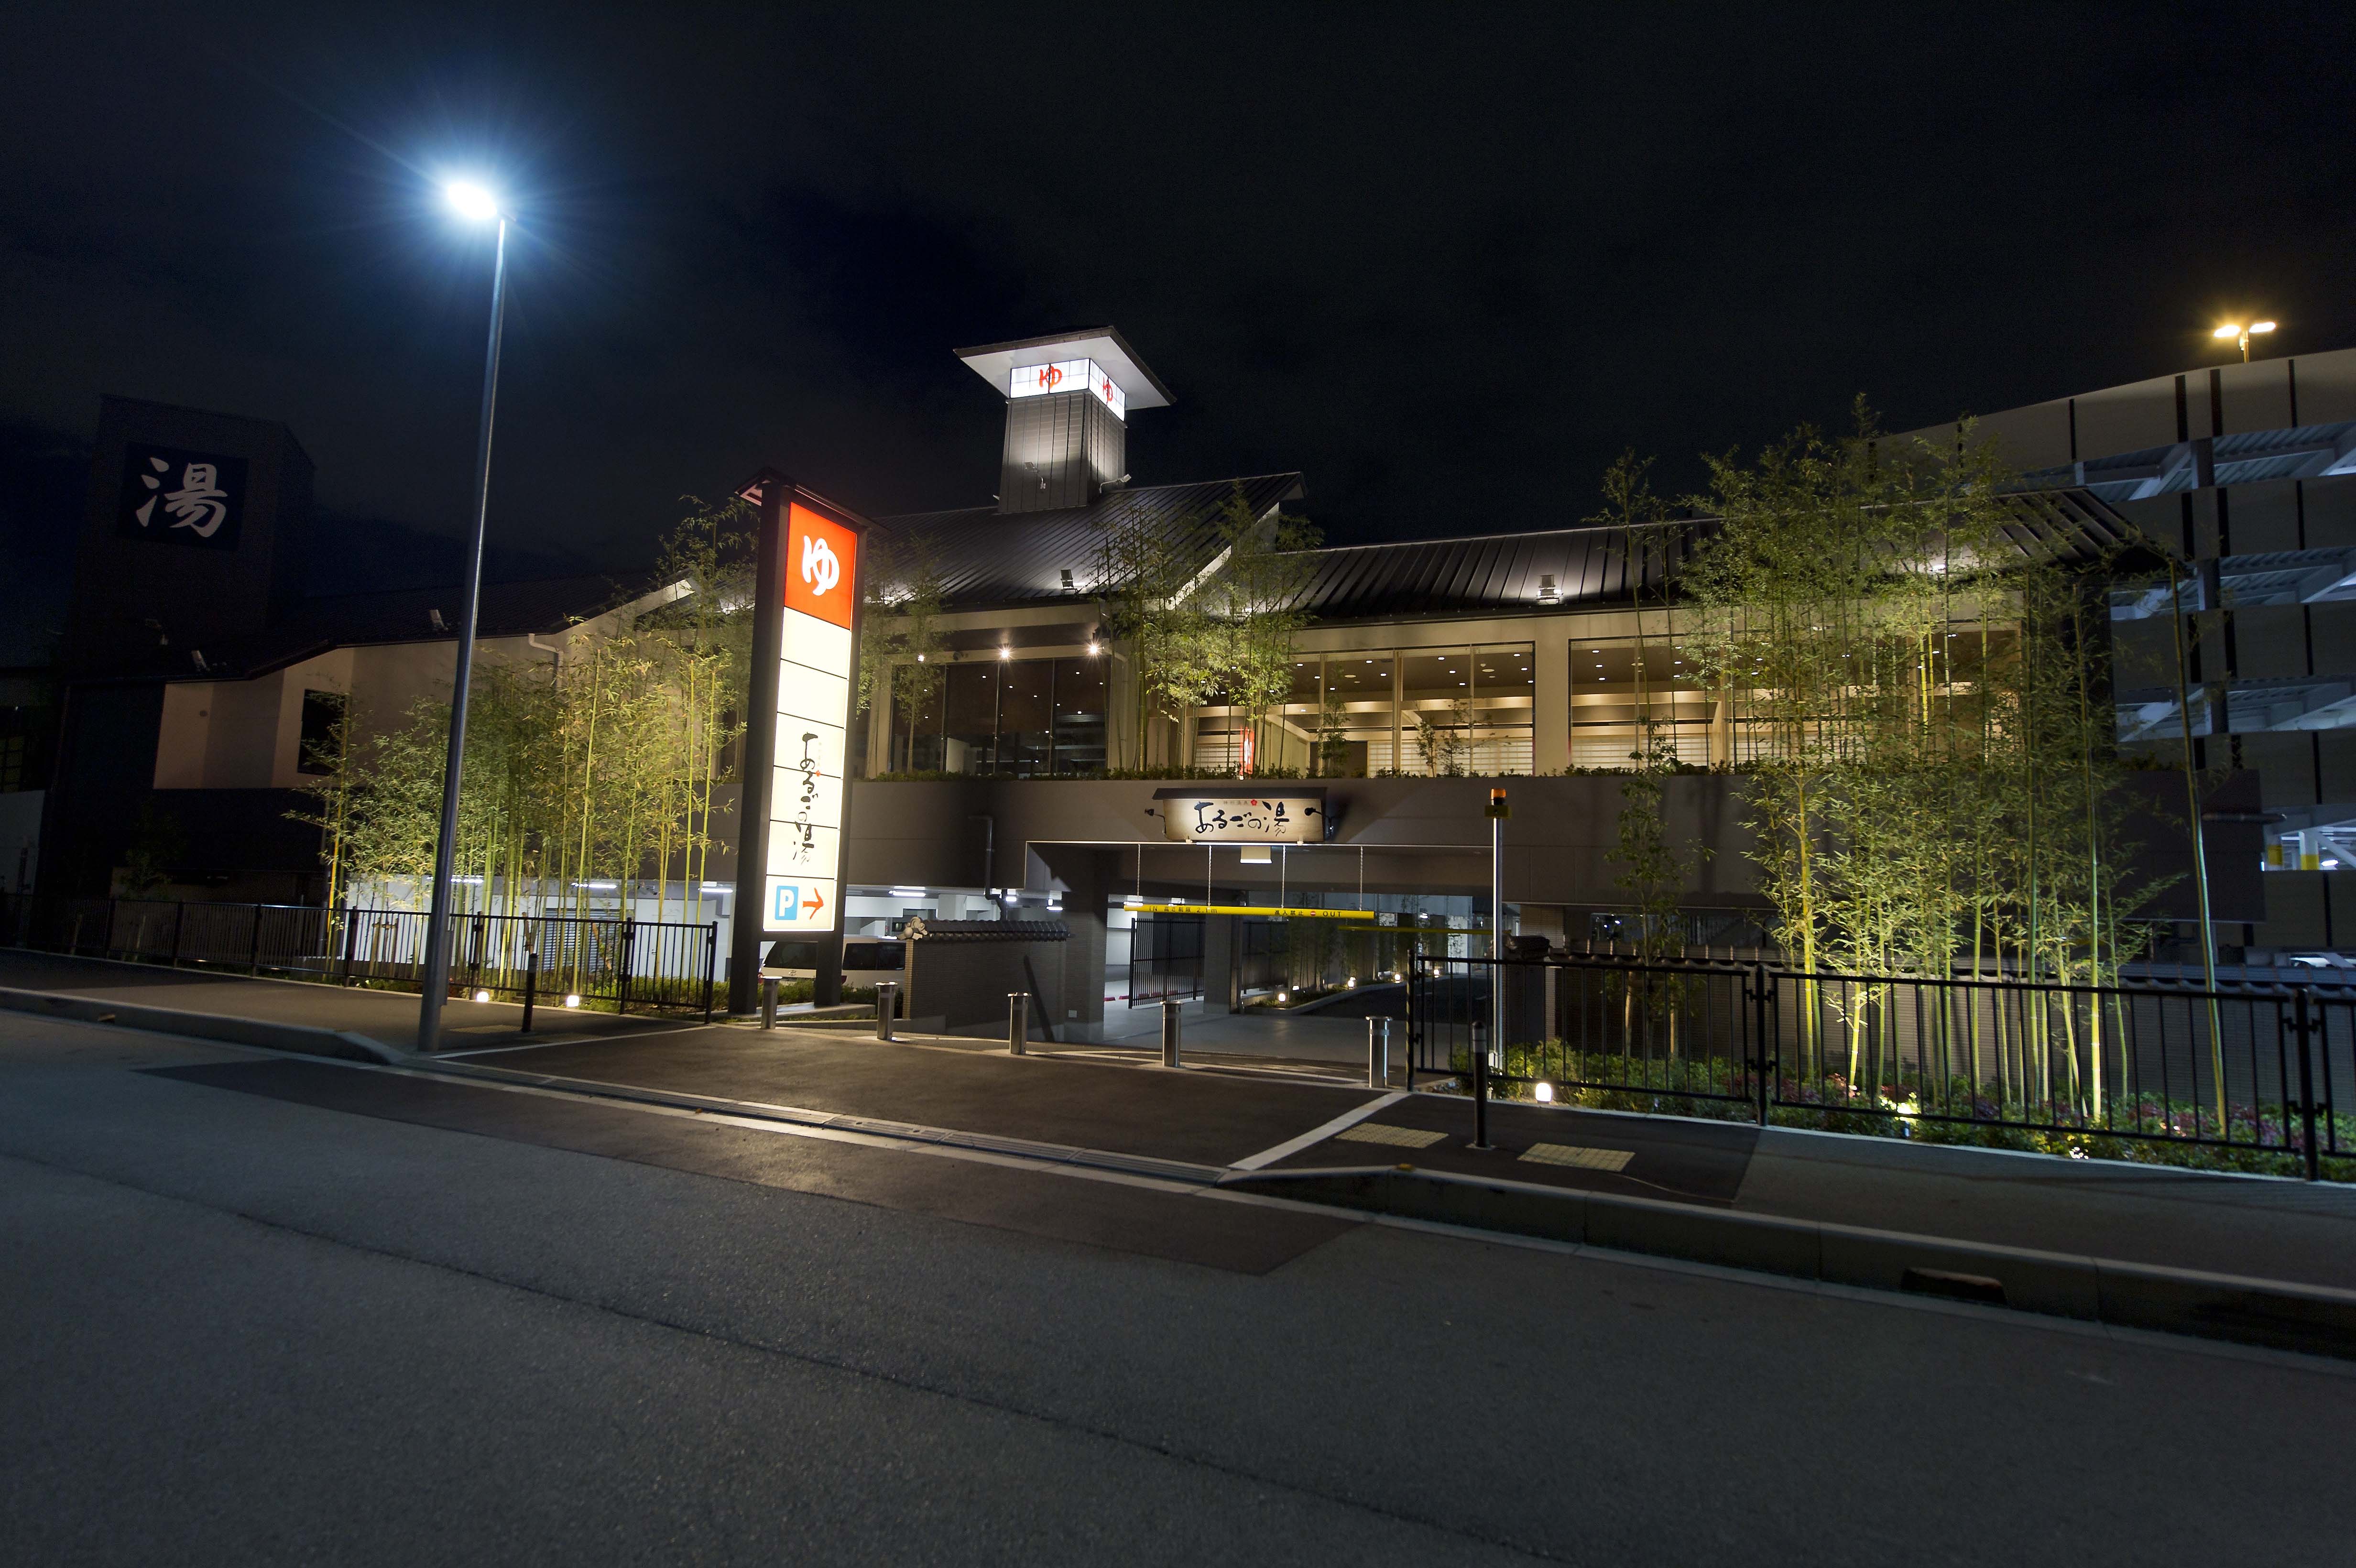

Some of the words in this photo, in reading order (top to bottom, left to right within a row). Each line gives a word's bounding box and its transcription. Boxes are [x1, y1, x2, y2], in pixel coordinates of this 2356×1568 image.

[1039, 366, 1062, 390] ゆ
[1102, 377, 1113, 403] ゆ
[136, 457, 229, 537] 湯
[802, 535, 840, 596] ゆ
[792, 731, 818, 865] あるごの湯
[1194, 801, 1290, 837] あるごの湯
[779, 889, 795, 917] P
